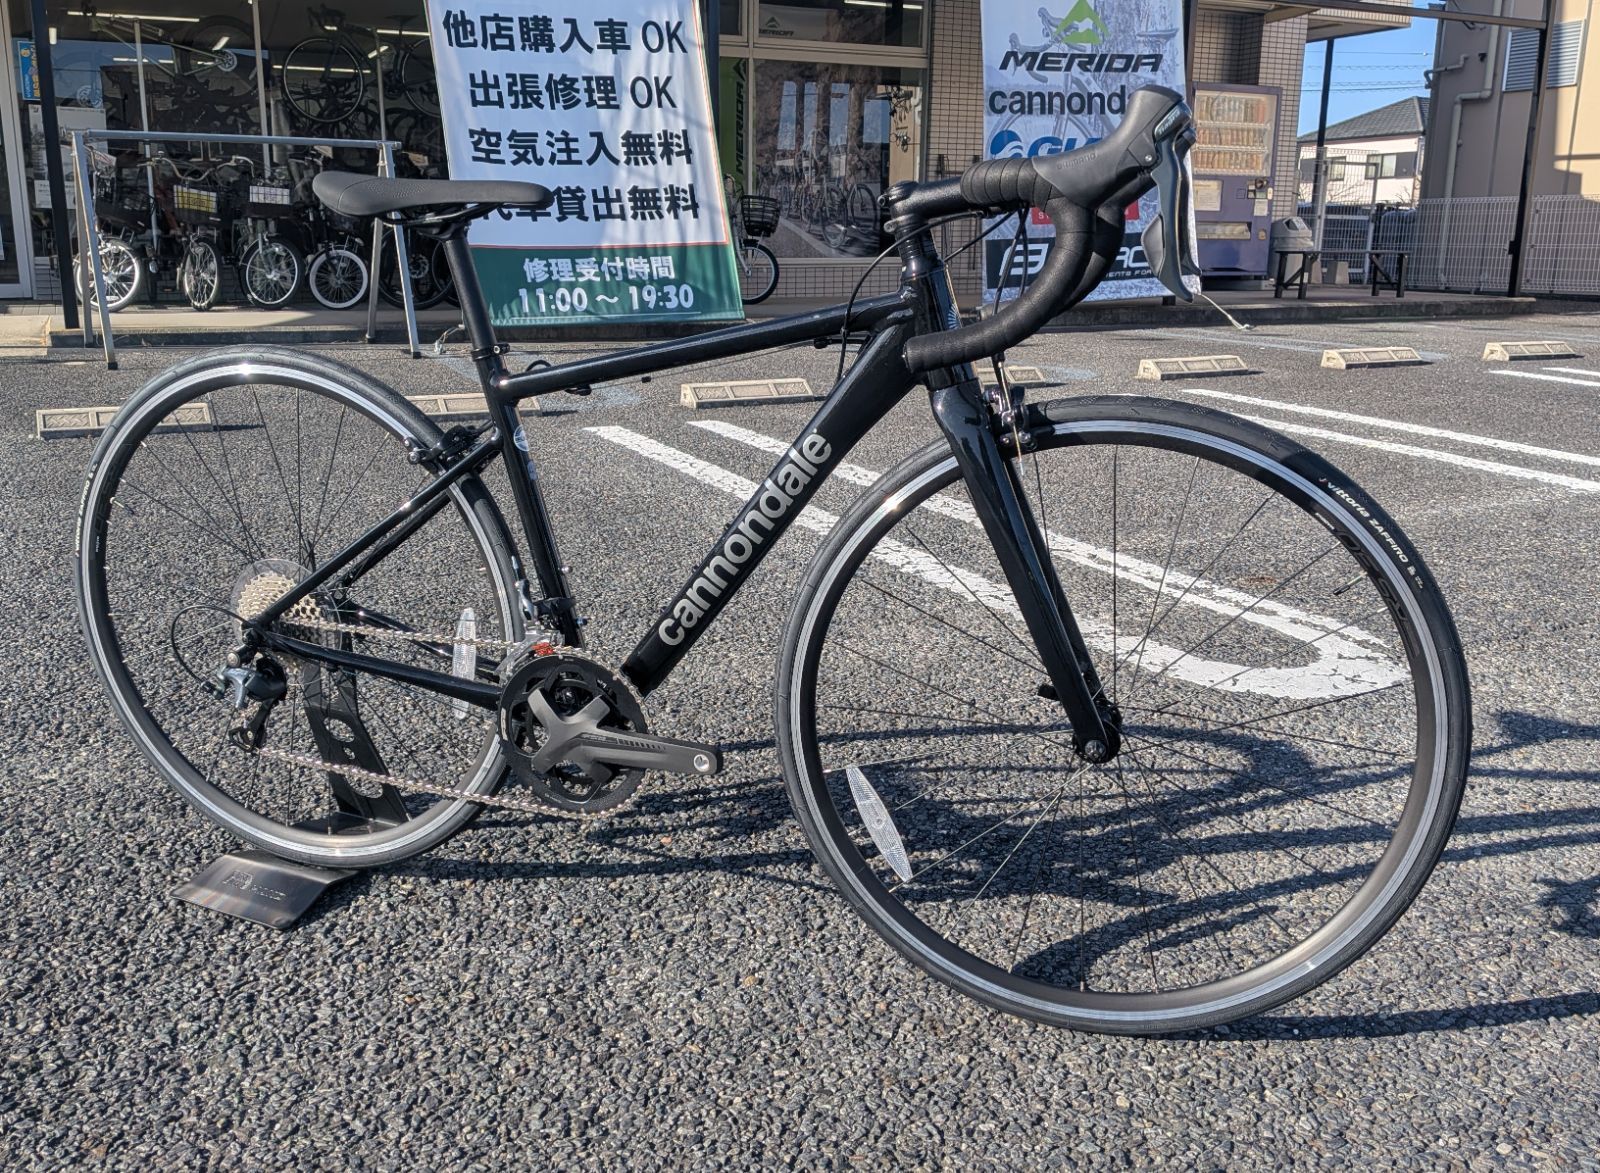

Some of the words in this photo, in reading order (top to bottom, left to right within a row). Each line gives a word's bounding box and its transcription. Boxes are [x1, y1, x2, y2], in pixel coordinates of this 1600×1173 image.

[442, 10, 631, 55] 他店購入車
[641, 20, 688, 53] OK
[999, 51, 1163, 73] MERIDA
[469, 70, 619, 110] 出張修理
[630, 76, 677, 108] OK
[988, 85, 1131, 115] cannond
[469, 128, 693, 166] 空気注入無料
[1028, 136, 1102, 158] GI
[523, 256, 676, 283] 修理受付時間
[519, 287, 588, 313] 11:00
[628, 284, 694, 310] 19:30
[1327, 482, 1370, 517] vittoria
[1369, 519, 1409, 562] ZAFFIRO
[658, 433, 832, 646] cannondale
